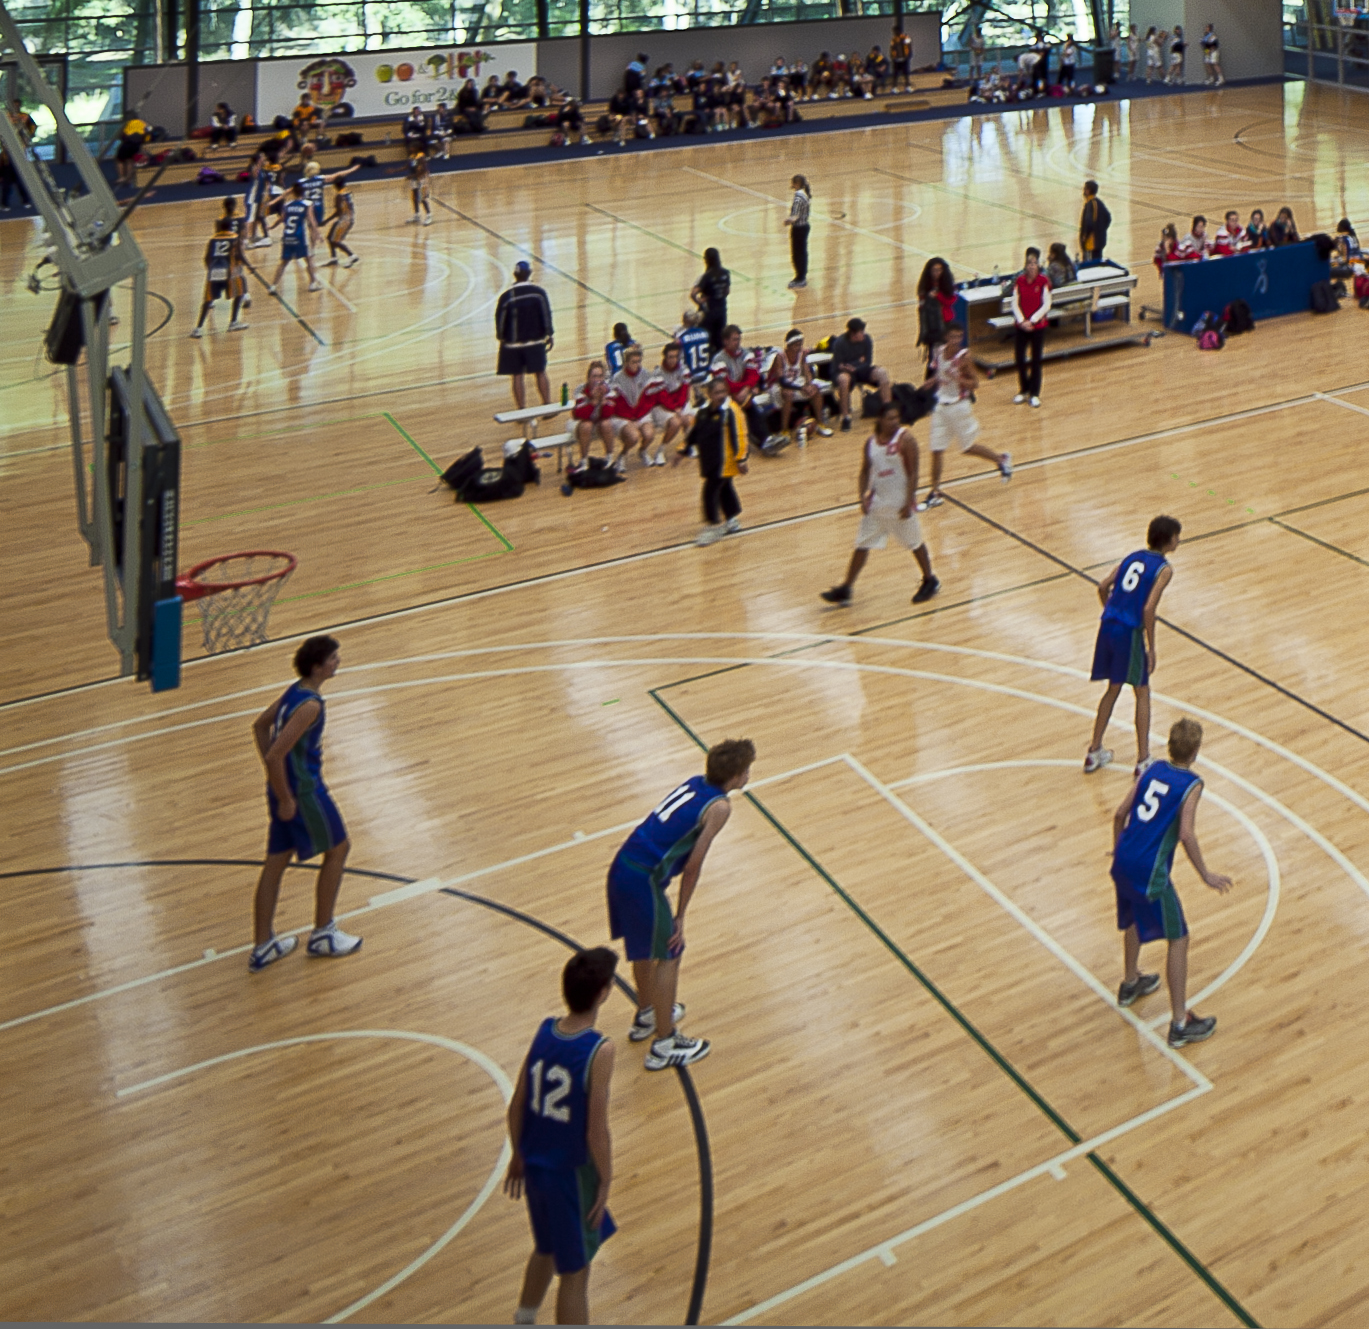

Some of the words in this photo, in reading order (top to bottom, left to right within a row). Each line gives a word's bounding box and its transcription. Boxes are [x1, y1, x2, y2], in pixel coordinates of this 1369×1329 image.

[384, 91, 410, 106] Go
[411, 89, 435, 104] for
[285, 216, 299, 234] 5
[213, 241, 231, 257] 12
[689, 343, 709, 370] 15
[1122, 561, 1145, 593] 6
[653, 784, 696, 823] 11
[1137, 779, 1170, 823] 5
[530, 1059, 572, 1123] 12
